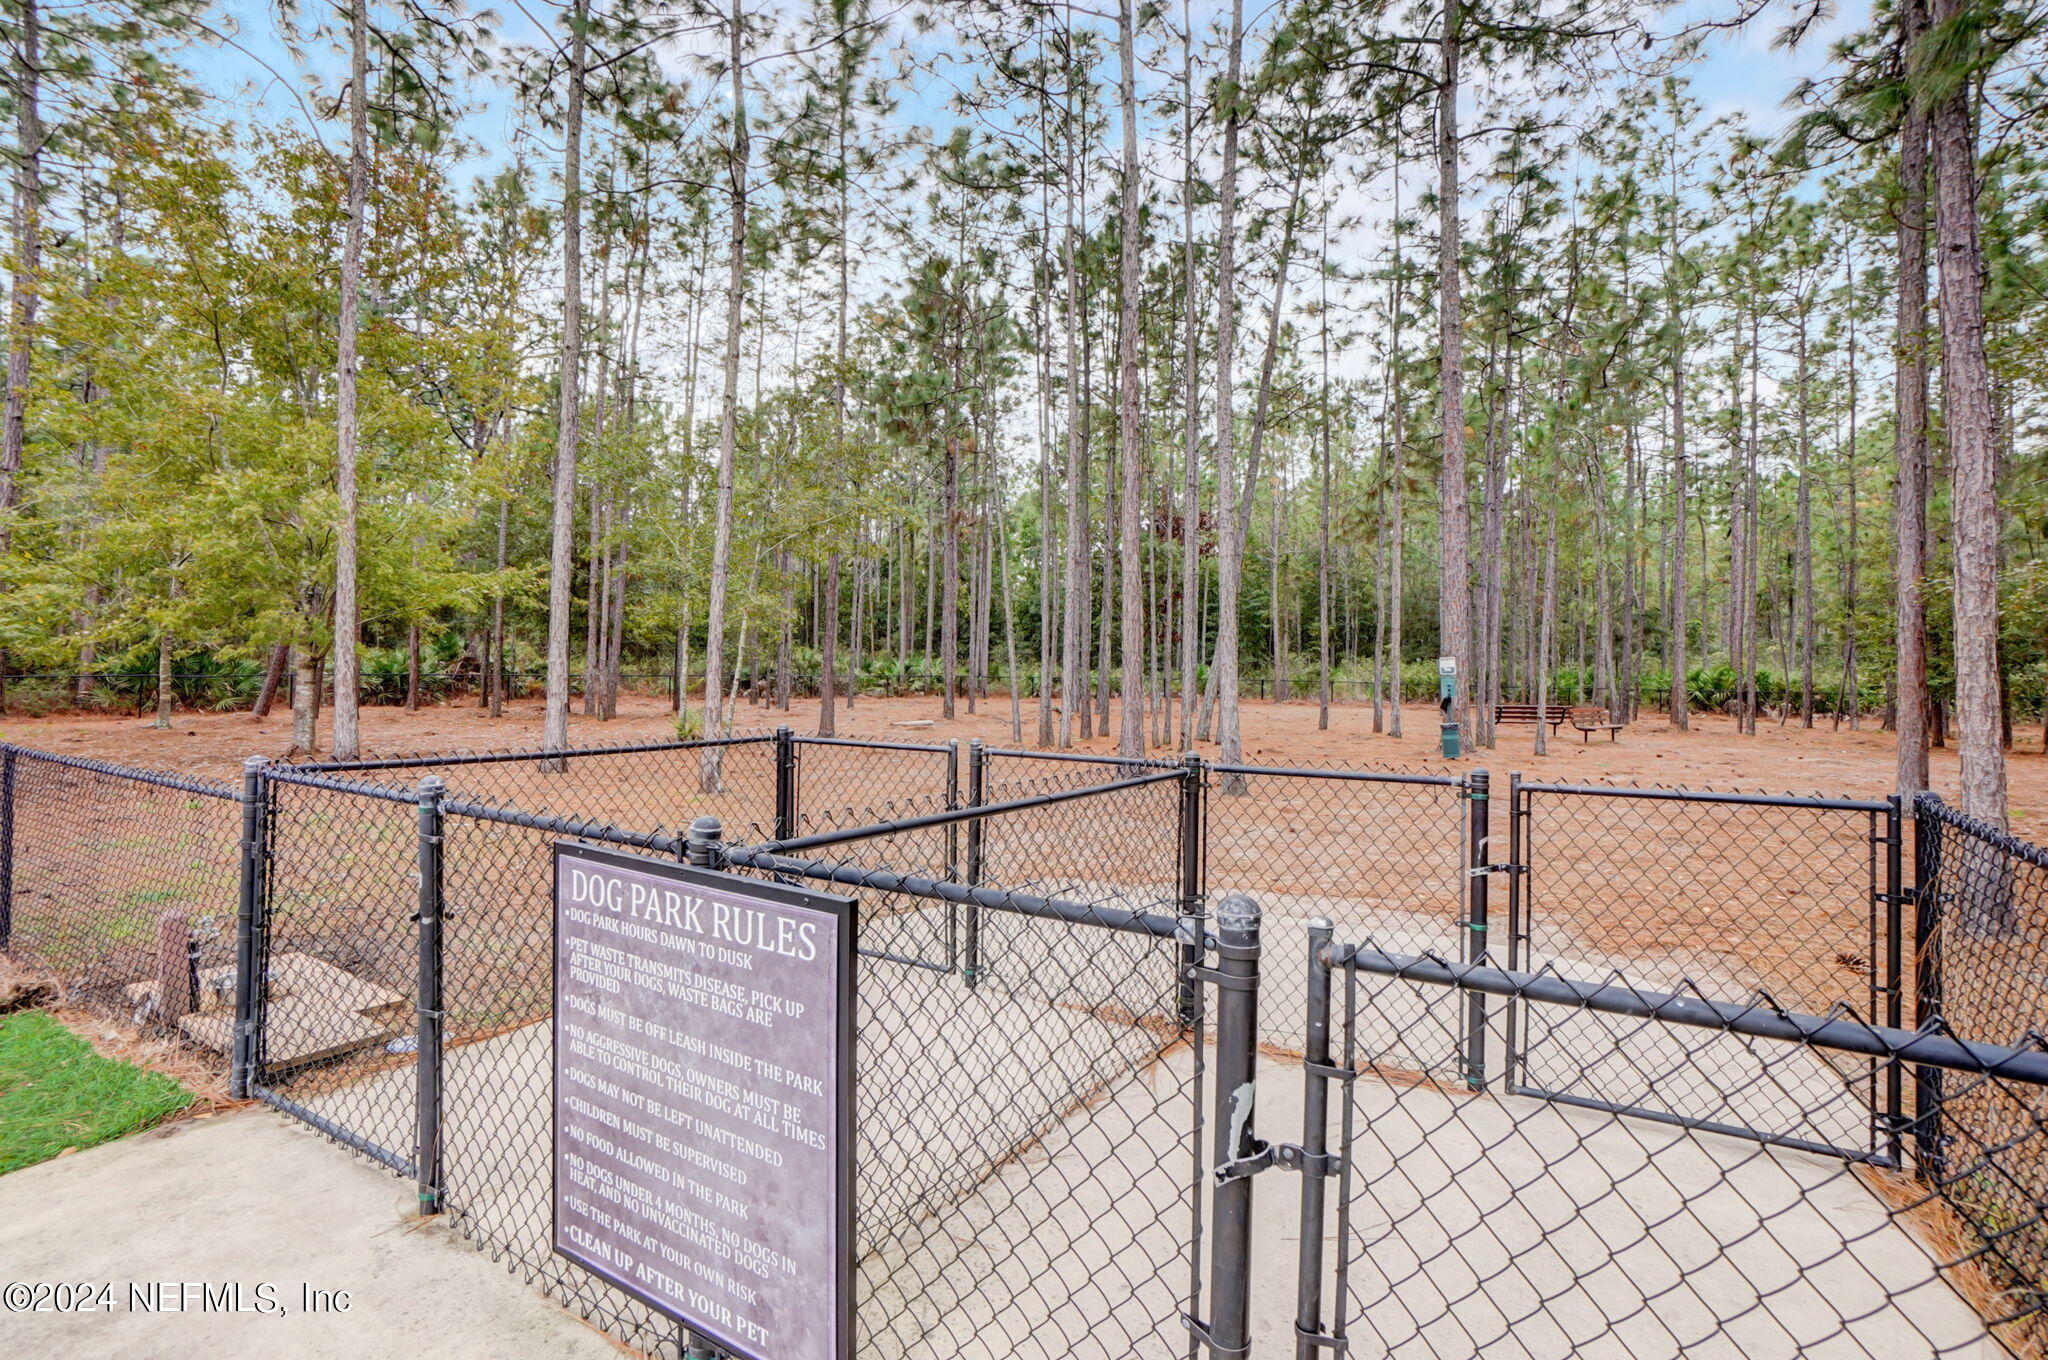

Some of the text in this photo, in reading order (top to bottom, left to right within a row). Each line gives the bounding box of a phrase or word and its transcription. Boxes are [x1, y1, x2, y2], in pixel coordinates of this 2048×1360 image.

[570, 908, 752, 970] DOG PARK HOURS DAWN TO DUSK
[571, 869, 816, 961] DOG PARK RULES
[570, 936, 805, 1019] PET WASTE TRANSMITS DISEASE, PICK UP
[570, 967, 620, 993] PROVIDED
[570, 953, 773, 1028] AFTER YOUR DOGS, WASTE BAGS ARE
[570, 996, 824, 1097] DOGS MUST BE OFF LEASH INSIDE THE PARK
[570, 1024, 801, 1124] NO AGGRESSIVE DOGS, OWNERS MUST BE
[570, 1038, 826, 1150] ABLE TO CONTROL THEIR DOG AT ALL TIMES
[570, 1067, 783, 1168] DOGS MAY NOT BE LEFT UNATTENDED
[570, 1096, 747, 1185] CHILDREN MUST BE SUPERVISED
[570, 1125, 748, 1220] NO FOOD ALLOWED IN THE PARK
[570, 1153, 796, 1276] NO DOGS UNDER 4 MONTHS, NO DOGS IN
[570, 1168, 769, 1279] HEAT, AND NO UNVACCINATED DOGS
[570, 1195, 757, 1306] USE THE PARK AT YOUR OWN RISK
[570, 1225, 769, 1348] CLEAN UP AFTER YOUR PET
